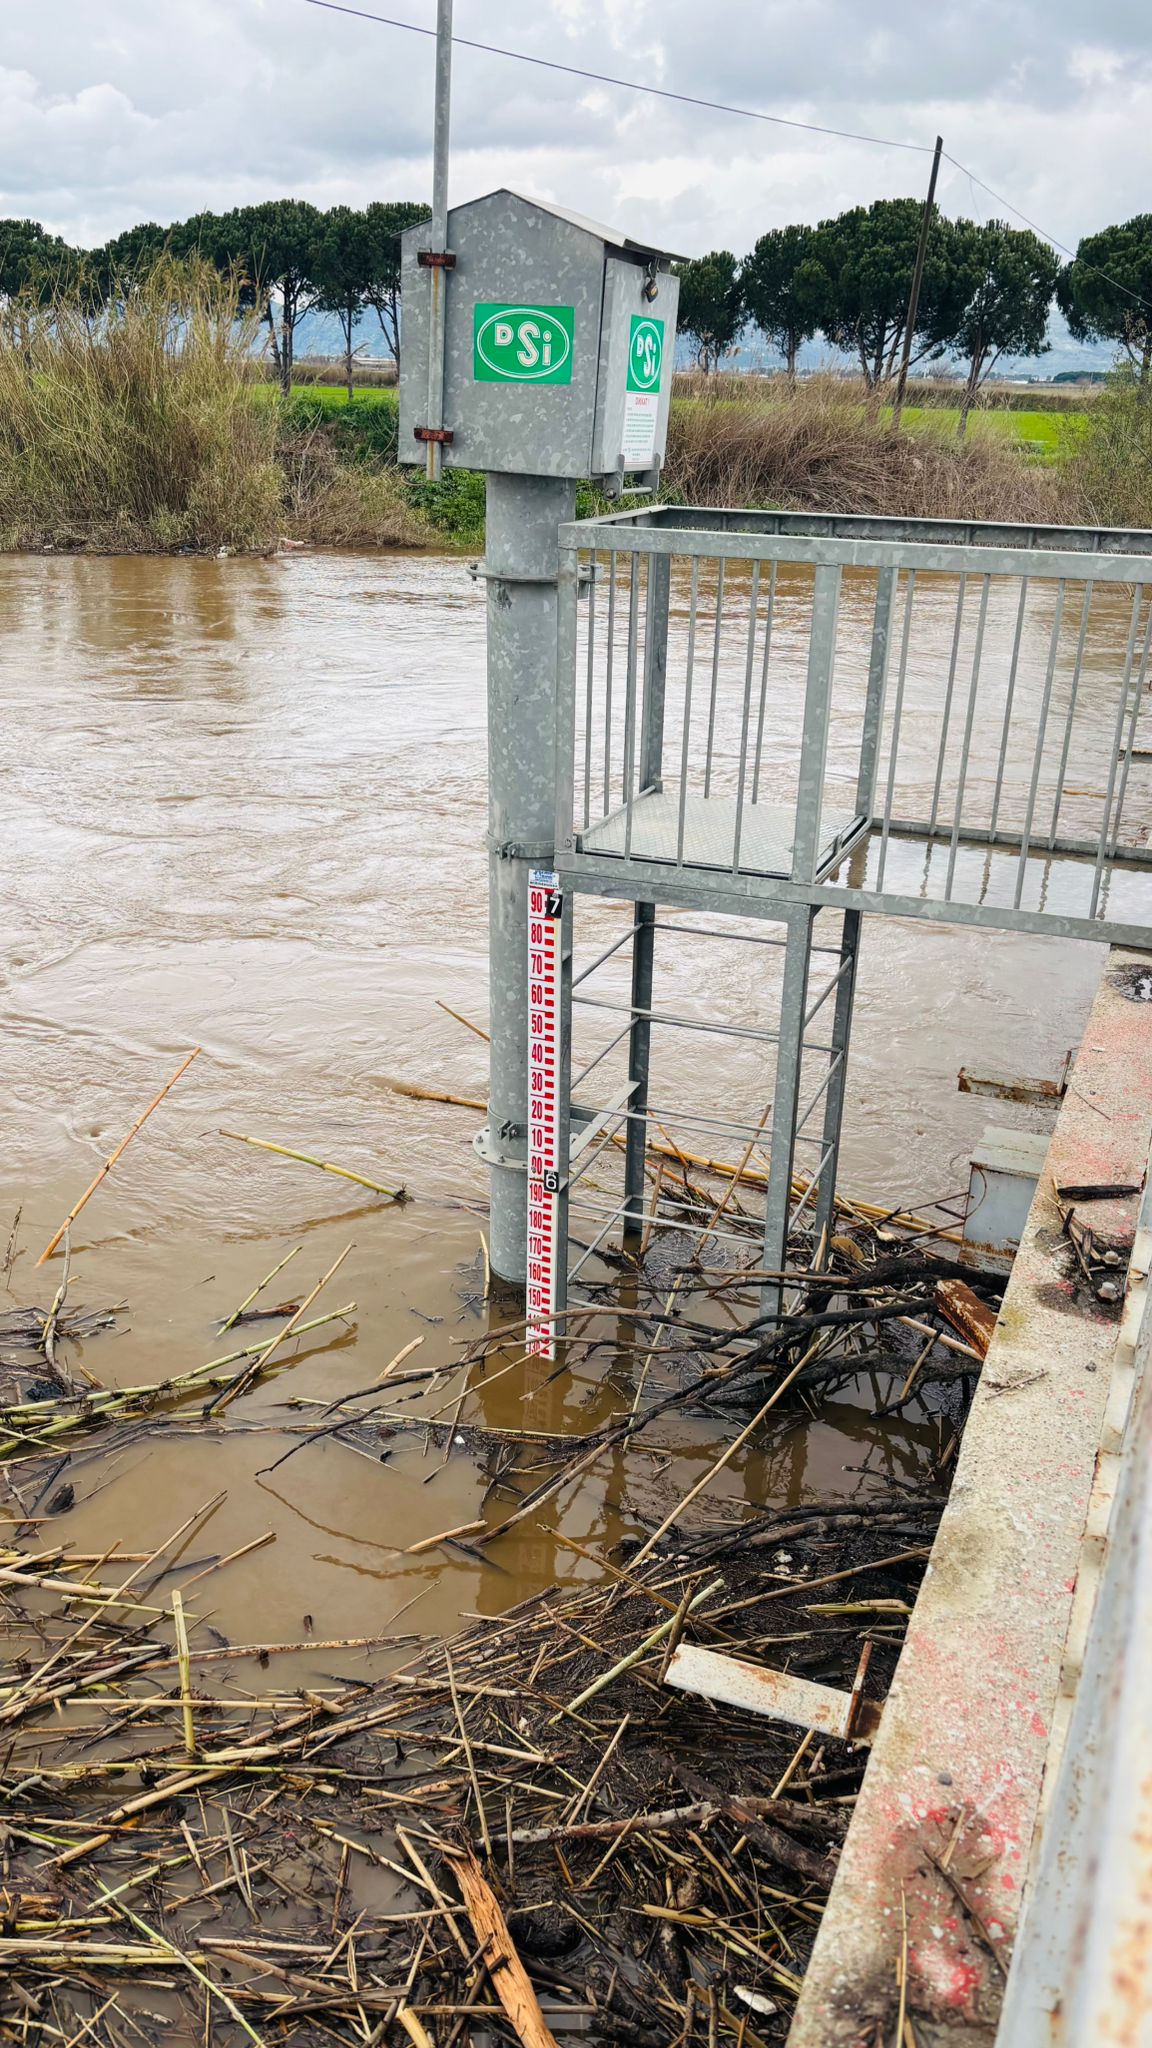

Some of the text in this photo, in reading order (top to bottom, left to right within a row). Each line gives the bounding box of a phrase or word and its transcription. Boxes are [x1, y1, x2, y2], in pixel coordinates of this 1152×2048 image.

[531, 891, 542, 913] 90
[549, 896, 560, 914] 7
[530, 923, 542, 944] 80
[530, 954, 542, 975] 70
[531, 984, 542, 1005] 60
[531, 1014, 542, 1034] 50
[531, 1043, 543, 1064] 40
[531, 1071, 543, 1092] 30
[531, 1100, 543, 1120] 20
[531, 1128, 542, 1148] 10
[545, 1174, 556, 1190] 6
[529, 1183, 542, 1202] 190
[529, 1211, 542, 1230] 180
[529, 1237, 542, 1256] 170
[529, 1263, 541, 1281] 160
[528, 1288, 541, 1307] 150
